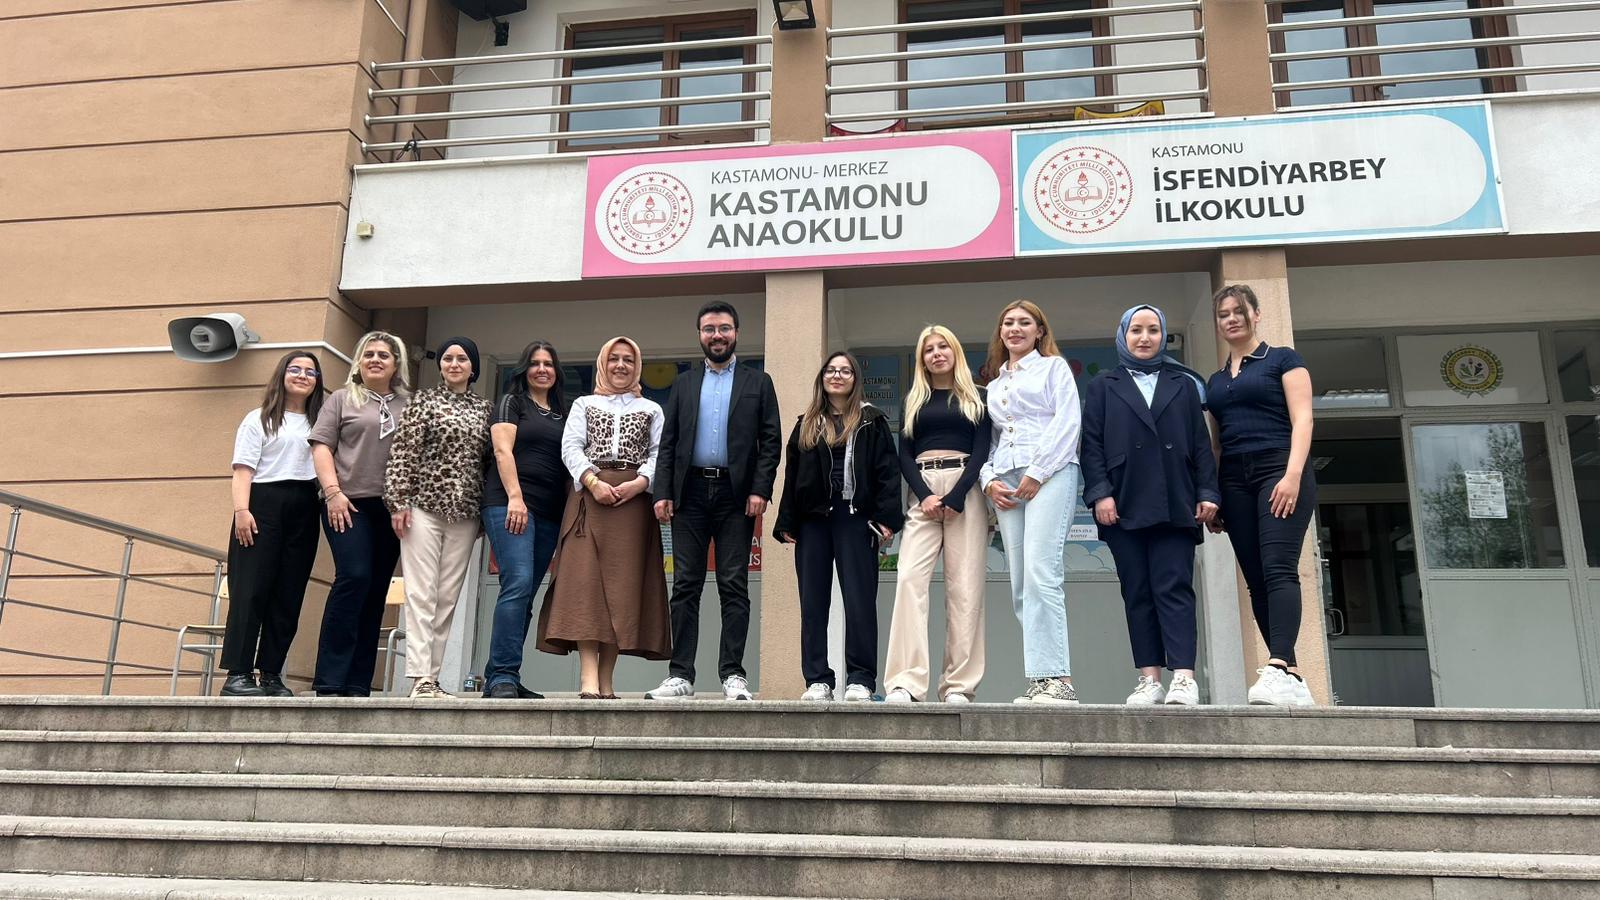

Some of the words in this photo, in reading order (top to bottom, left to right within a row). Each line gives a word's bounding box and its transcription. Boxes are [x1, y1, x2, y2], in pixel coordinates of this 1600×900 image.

[1152, 142, 1244, 158] KASTAMONU
[710, 166, 820, 185] KASTAMONU-
[823, 161, 889, 178] MERKEZ
[1153, 157, 1386, 192] İSFENDİYARBEY
[710, 180, 928, 217] KASTAMONU
[1155, 194, 1305, 223] İLKOKULU
[707, 214, 903, 249] ANAOKULU
[864, 376, 896, 385] ASTAMONU
[866, 391, 895, 399] NAOKULU
